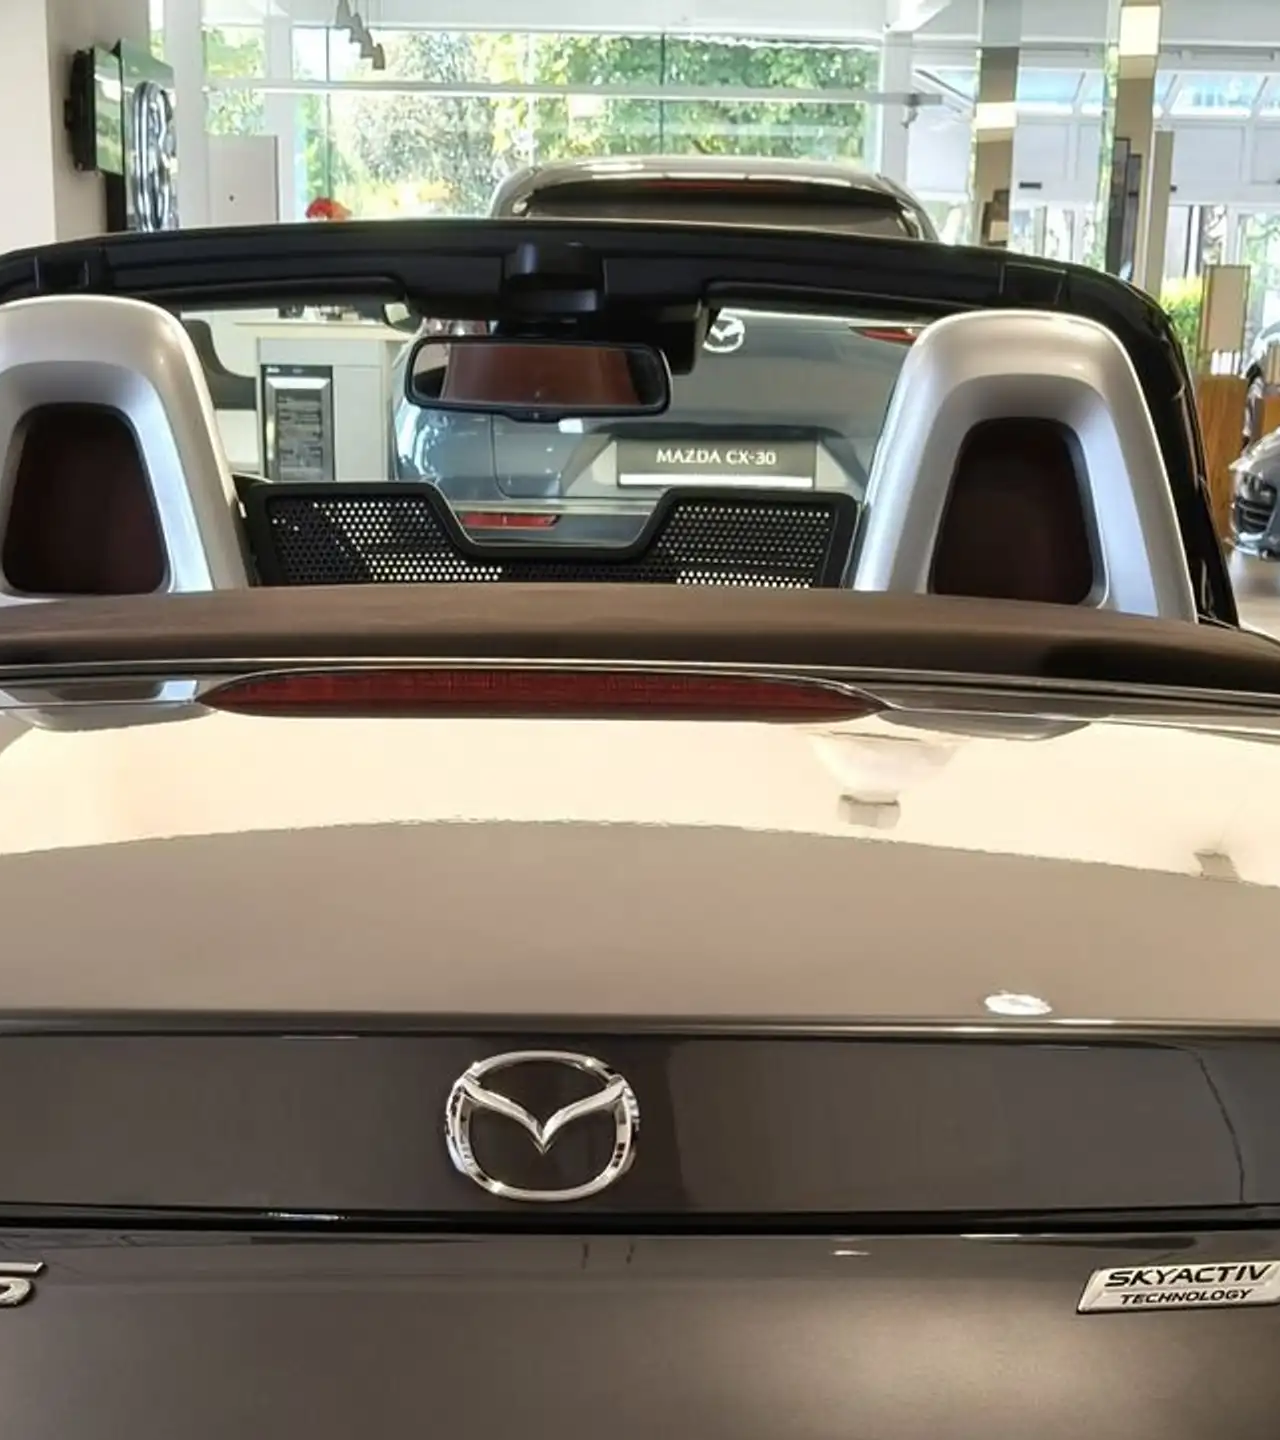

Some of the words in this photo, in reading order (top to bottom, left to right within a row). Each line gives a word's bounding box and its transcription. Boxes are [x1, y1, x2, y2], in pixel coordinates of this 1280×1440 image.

[656, 448, 721, 464] MAZDA
[726, 450, 777, 465] CX-30
[1104, 1264, 1272, 1287] SKYACTIV
[1121, 1288, 1253, 1305] TECHNOLOGY
